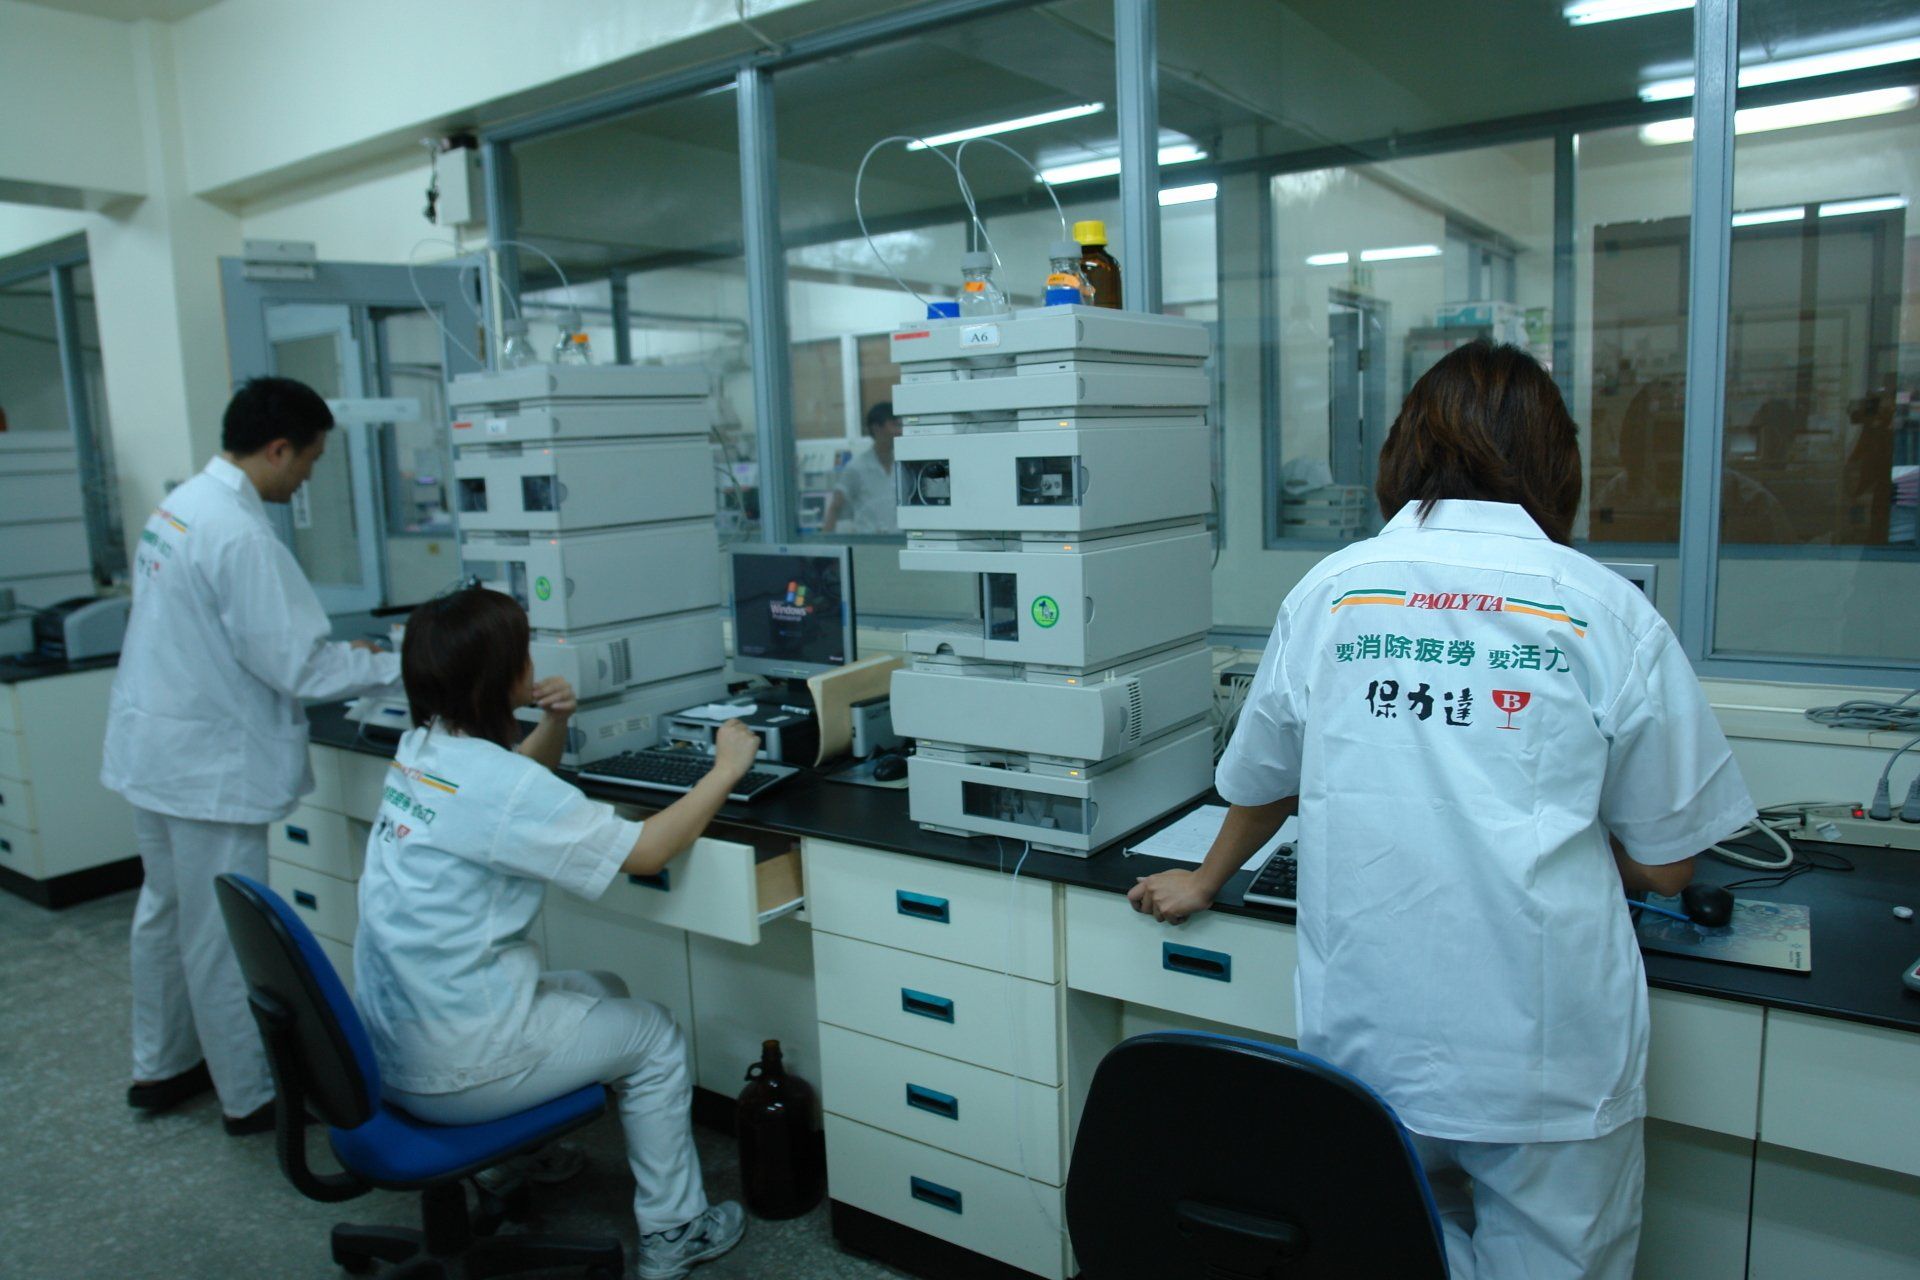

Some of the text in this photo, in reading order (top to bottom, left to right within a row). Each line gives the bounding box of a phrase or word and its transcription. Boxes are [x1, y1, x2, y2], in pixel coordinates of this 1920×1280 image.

[970, 332, 988, 343] A6
[1406, 592, 1503, 612] PAOLYTA
[1336, 633, 1571, 673] 要消除疲勞 要活力
[1365, 680, 1474, 727] 保力達
[1501, 693, 1522, 709] B
